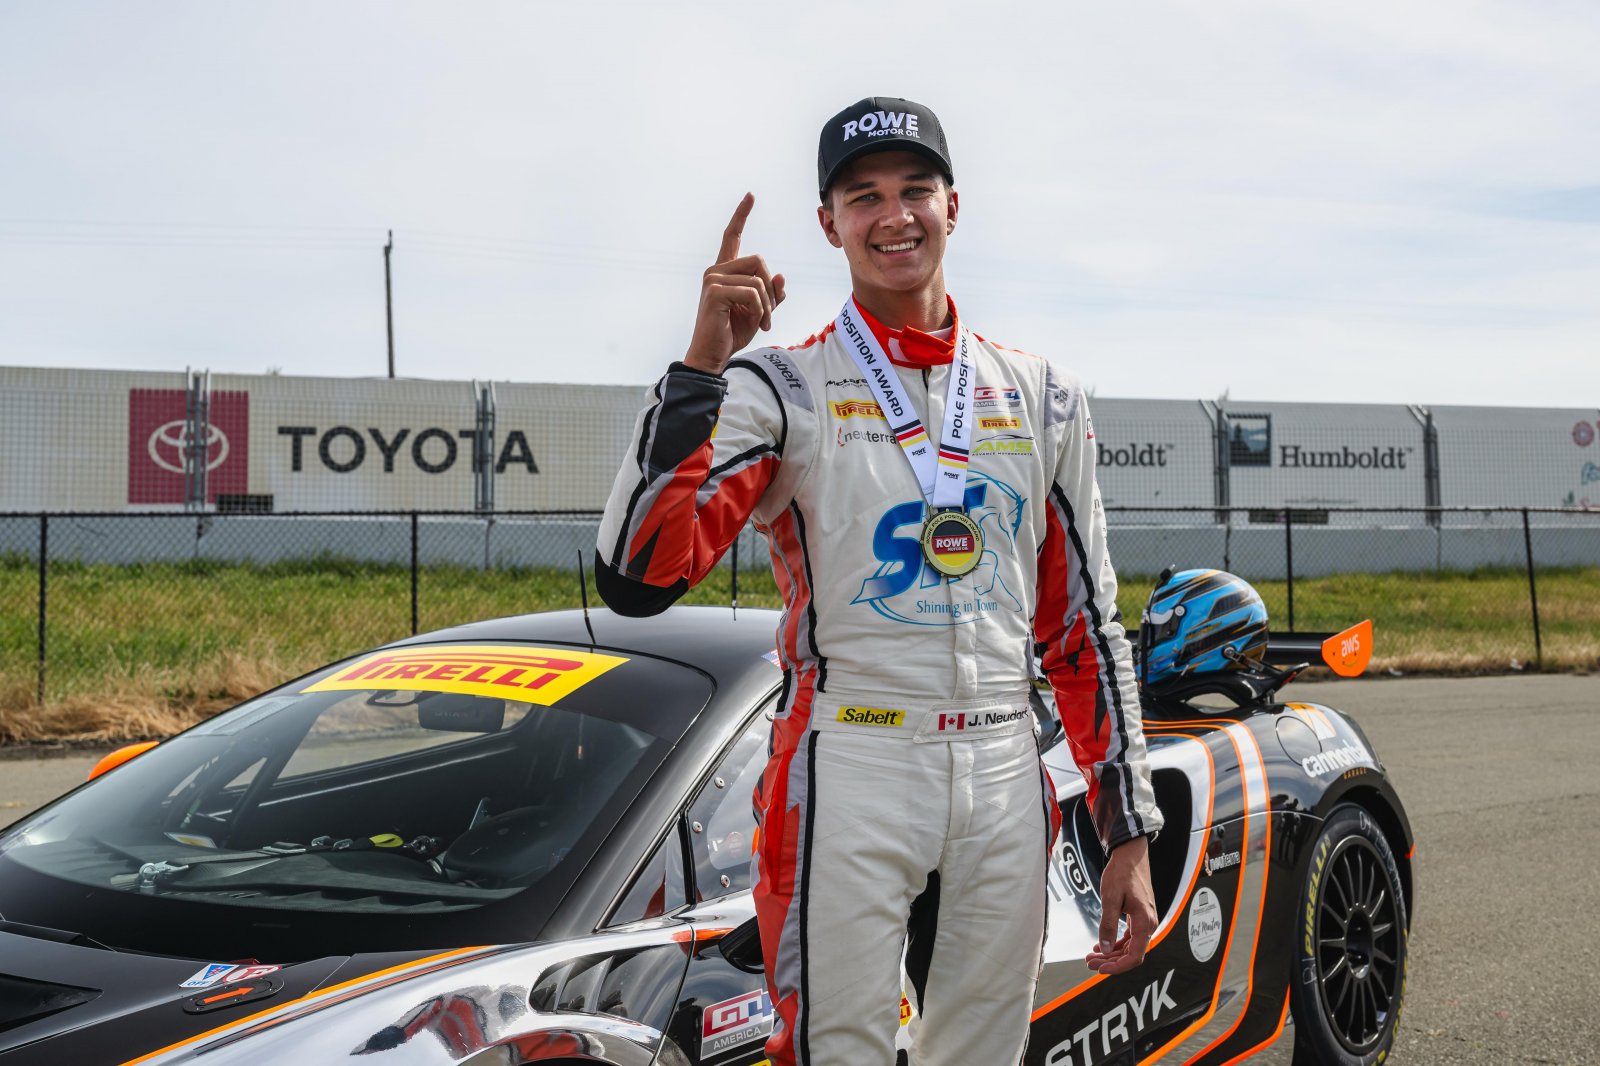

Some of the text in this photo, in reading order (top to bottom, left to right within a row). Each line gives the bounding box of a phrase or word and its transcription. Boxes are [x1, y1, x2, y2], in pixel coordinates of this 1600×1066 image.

[842, 111, 918, 141] ROWE
[868, 128, 920, 138] MOTOR OIL
[763, 353, 803, 390] Sabelt
[841, 311, 876, 365] POSITION
[872, 367, 904, 418] AWARD
[951, 334, 969, 439] POLE POSITION
[844, 430, 896, 444] neuterra
[972, 441, 1034, 453] AMS
[277, 426, 540, 474] TOYOTA
[1096, 443, 1167, 467] boldt
[1279, 445, 1407, 469] Humboldt
[935, 537, 968, 548] ROWE
[916, 598, 998, 618] Shining in Town
[1341, 634, 1360, 657] aws
[336, 653, 585, 690] PIRELLI
[843, 708, 899, 725] Sabelt
[968, 714, 982, 727] J.
[1305, 842, 1327, 956] PIRELLI
[1045, 968, 1178, 1066] STRYK
[713, 1026, 762, 1050] AMERICA
